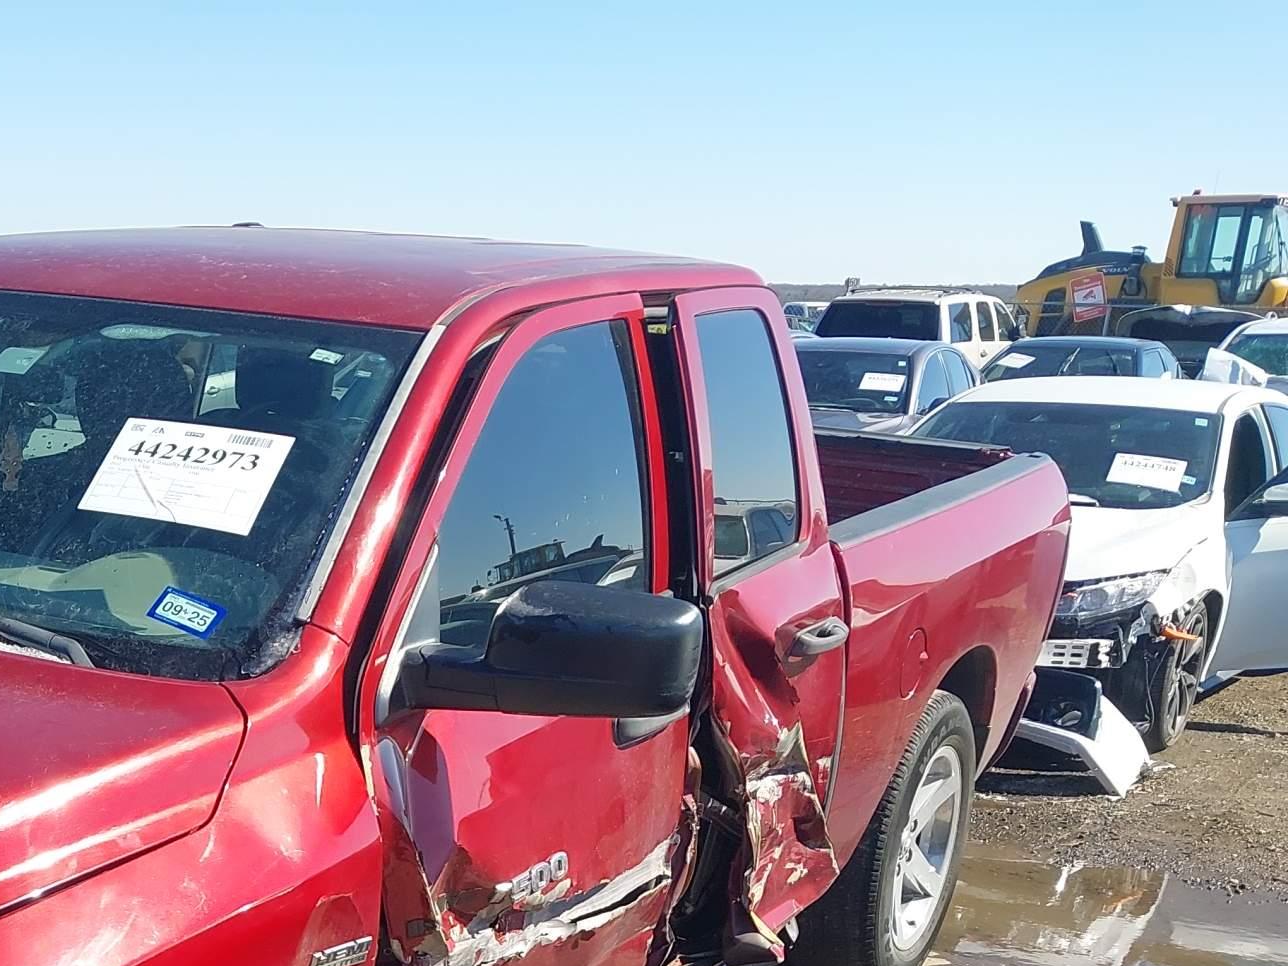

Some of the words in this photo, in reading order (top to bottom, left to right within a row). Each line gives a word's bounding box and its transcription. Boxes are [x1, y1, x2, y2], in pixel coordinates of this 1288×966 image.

[128, 439, 260, 471] 44242973
[162, 601, 183, 616] 09
[187, 611, 210, 626] 25
